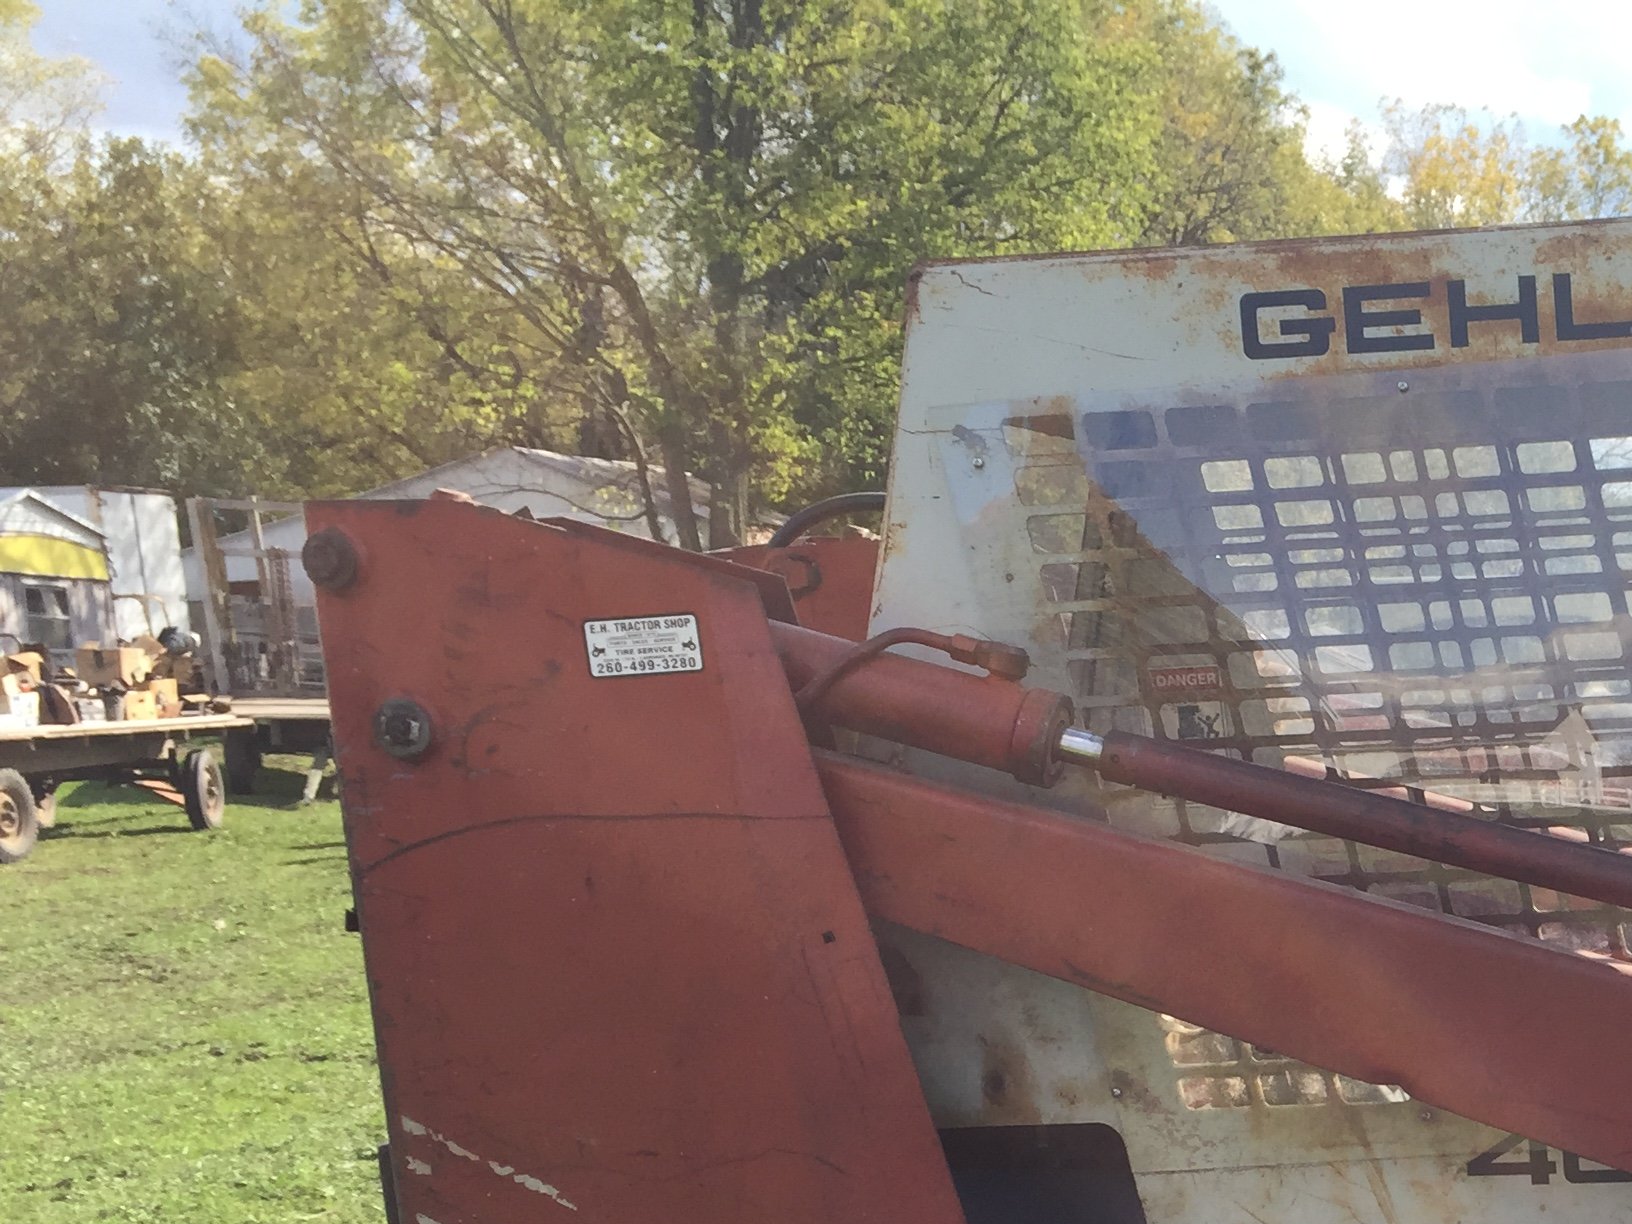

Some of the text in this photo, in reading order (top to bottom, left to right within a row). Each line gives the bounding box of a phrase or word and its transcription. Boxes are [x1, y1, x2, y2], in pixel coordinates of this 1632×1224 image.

[614, 620, 661, 633] TRACTOR
[664, 617, 691, 629] SHOP
[615, 645, 673, 656] TIRE SERVICE
[597, 656, 696, 674] 260-499-3280
[1156, 671, 1217, 688] DANGER
